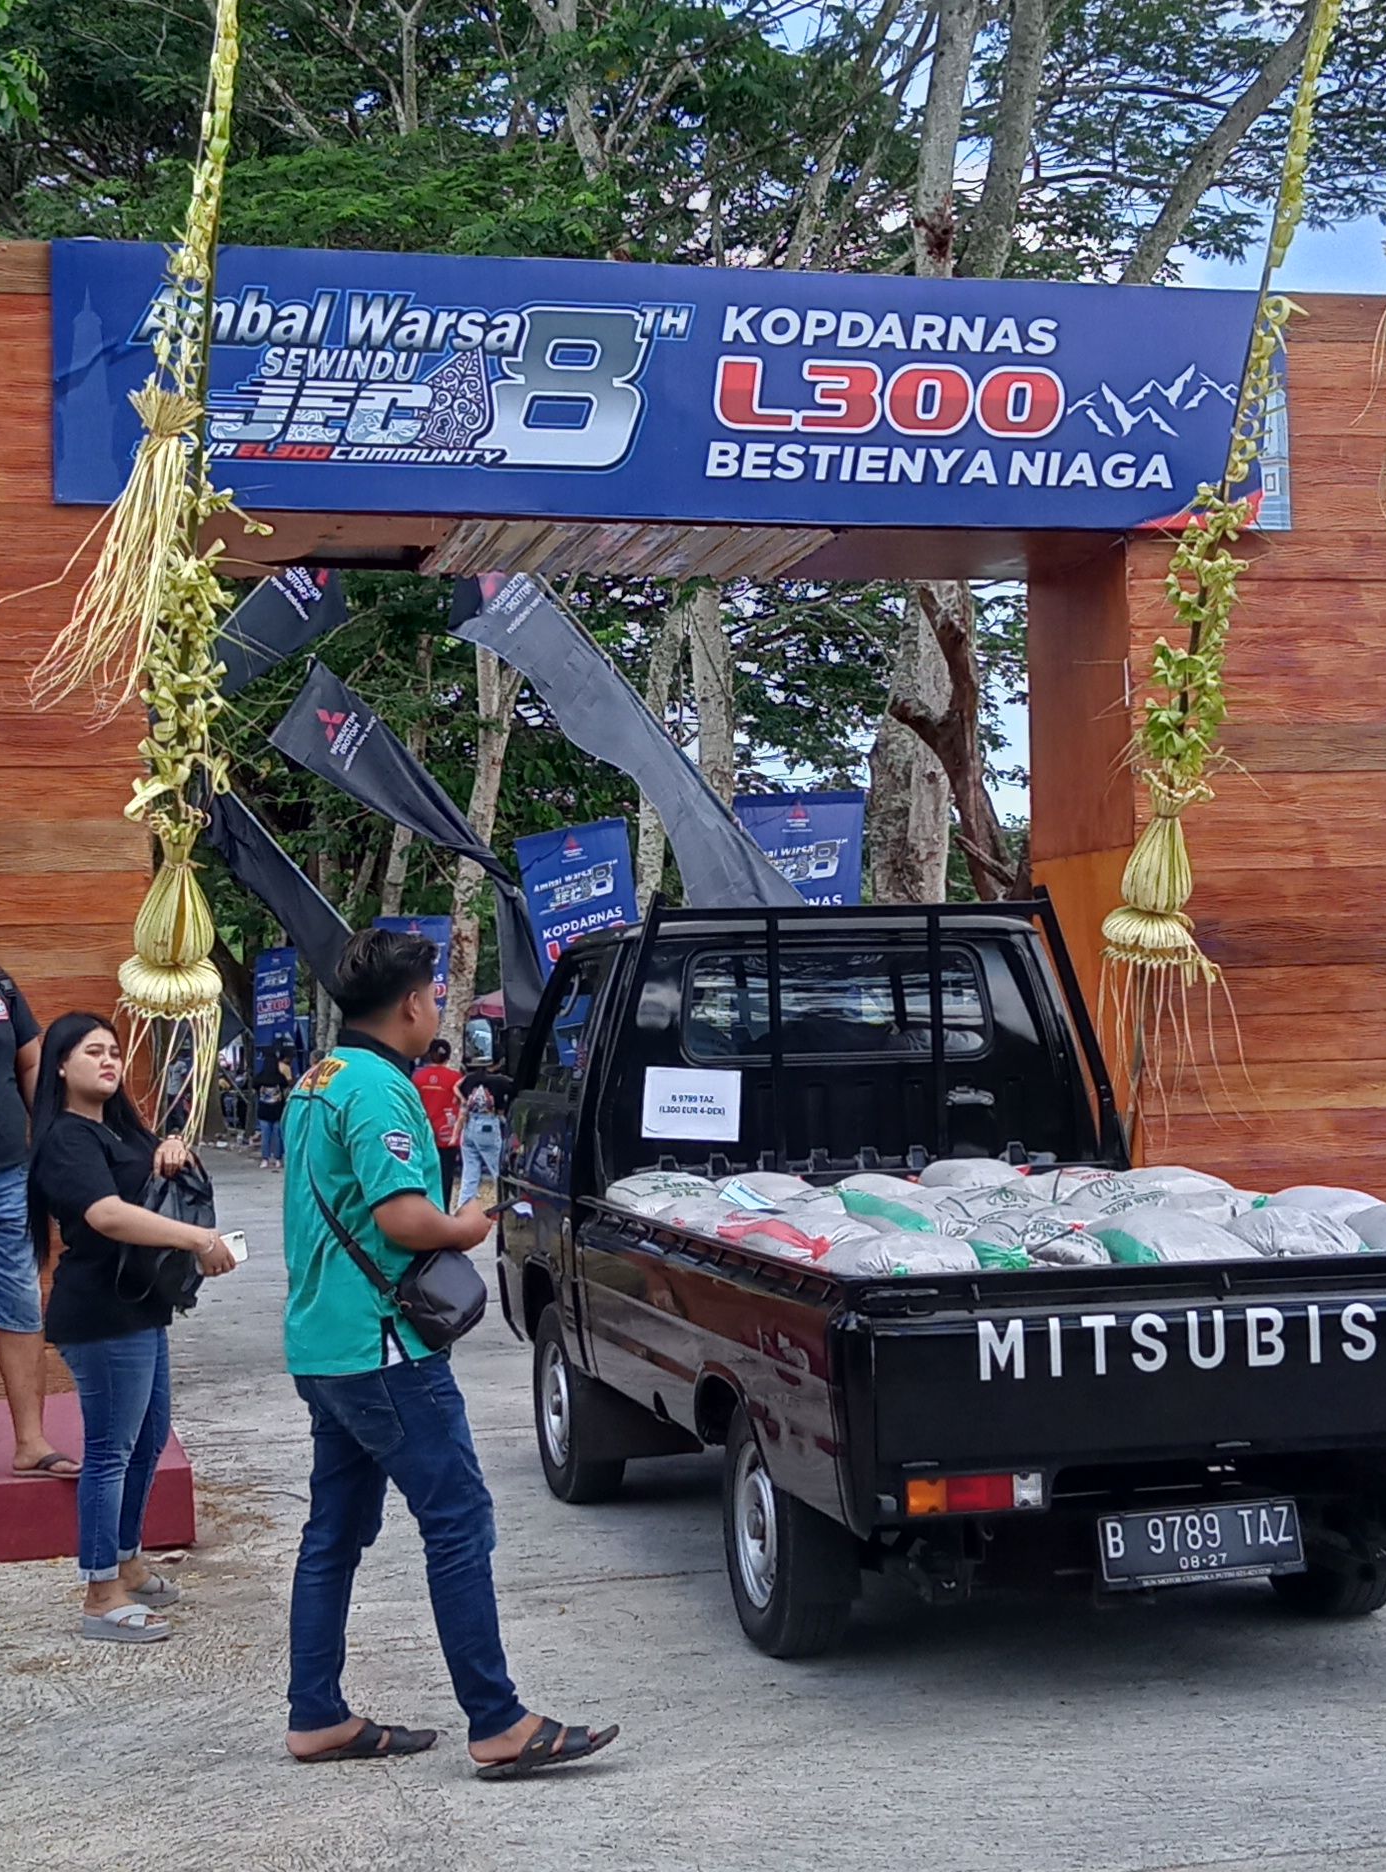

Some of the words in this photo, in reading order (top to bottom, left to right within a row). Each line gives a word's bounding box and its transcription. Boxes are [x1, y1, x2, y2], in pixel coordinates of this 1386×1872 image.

[346, 292, 520, 352] Warsa
[721, 305, 1059, 354] KOPDARNAS
[261, 347, 420, 381] SEWINDU
[207, 379, 430, 443] JEC
[714, 356, 1065, 438] L300
[329, 448, 505, 465] COMMUNITY
[706, 441, 998, 486] BESTIENYA
[1007, 450, 1174, 489] NIAGA
[542, 905, 624, 940] KOPDARNAS
[699, 1095, 714, 1104] TAZ
[1105, 1521, 1125, 1559] B
[1147, 1512, 1222, 1554] 9789
[1237, 1505, 1294, 1547] TAZ
